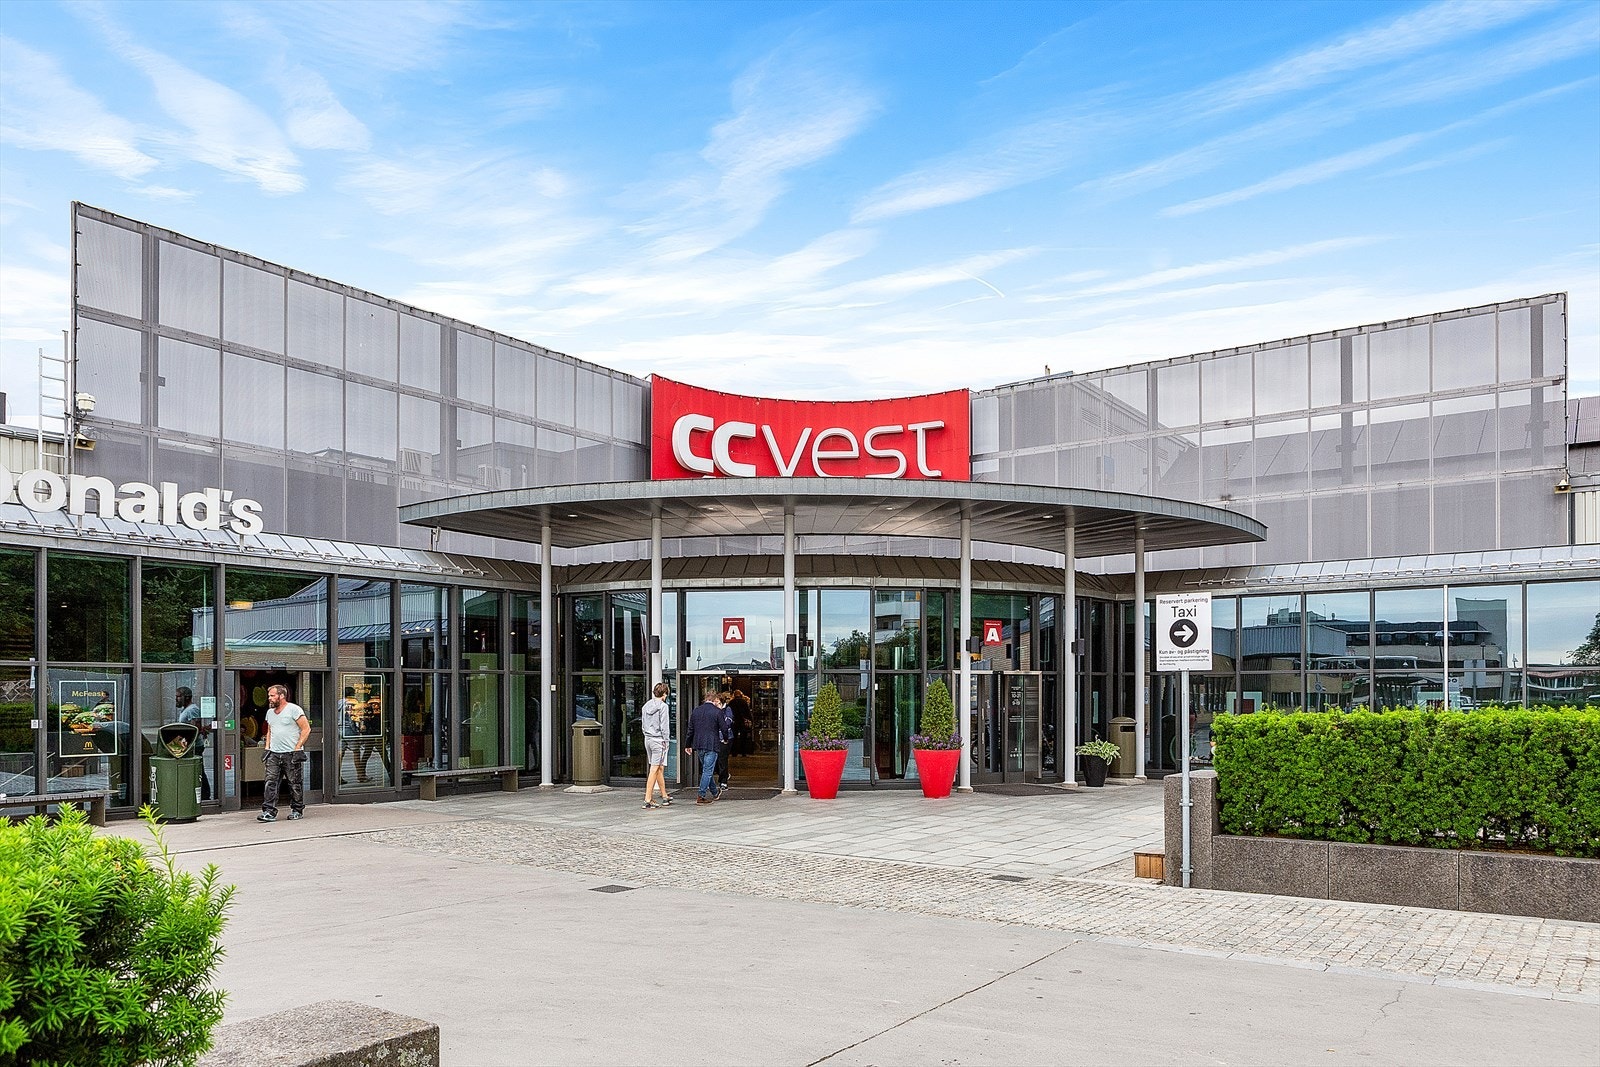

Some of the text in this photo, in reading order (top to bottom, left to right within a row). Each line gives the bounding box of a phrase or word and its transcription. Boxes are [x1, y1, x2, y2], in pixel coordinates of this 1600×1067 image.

[1171, 605, 1197, 617] Taxi
[726, 625, 742, 639] A
[986, 628, 999, 641] A
